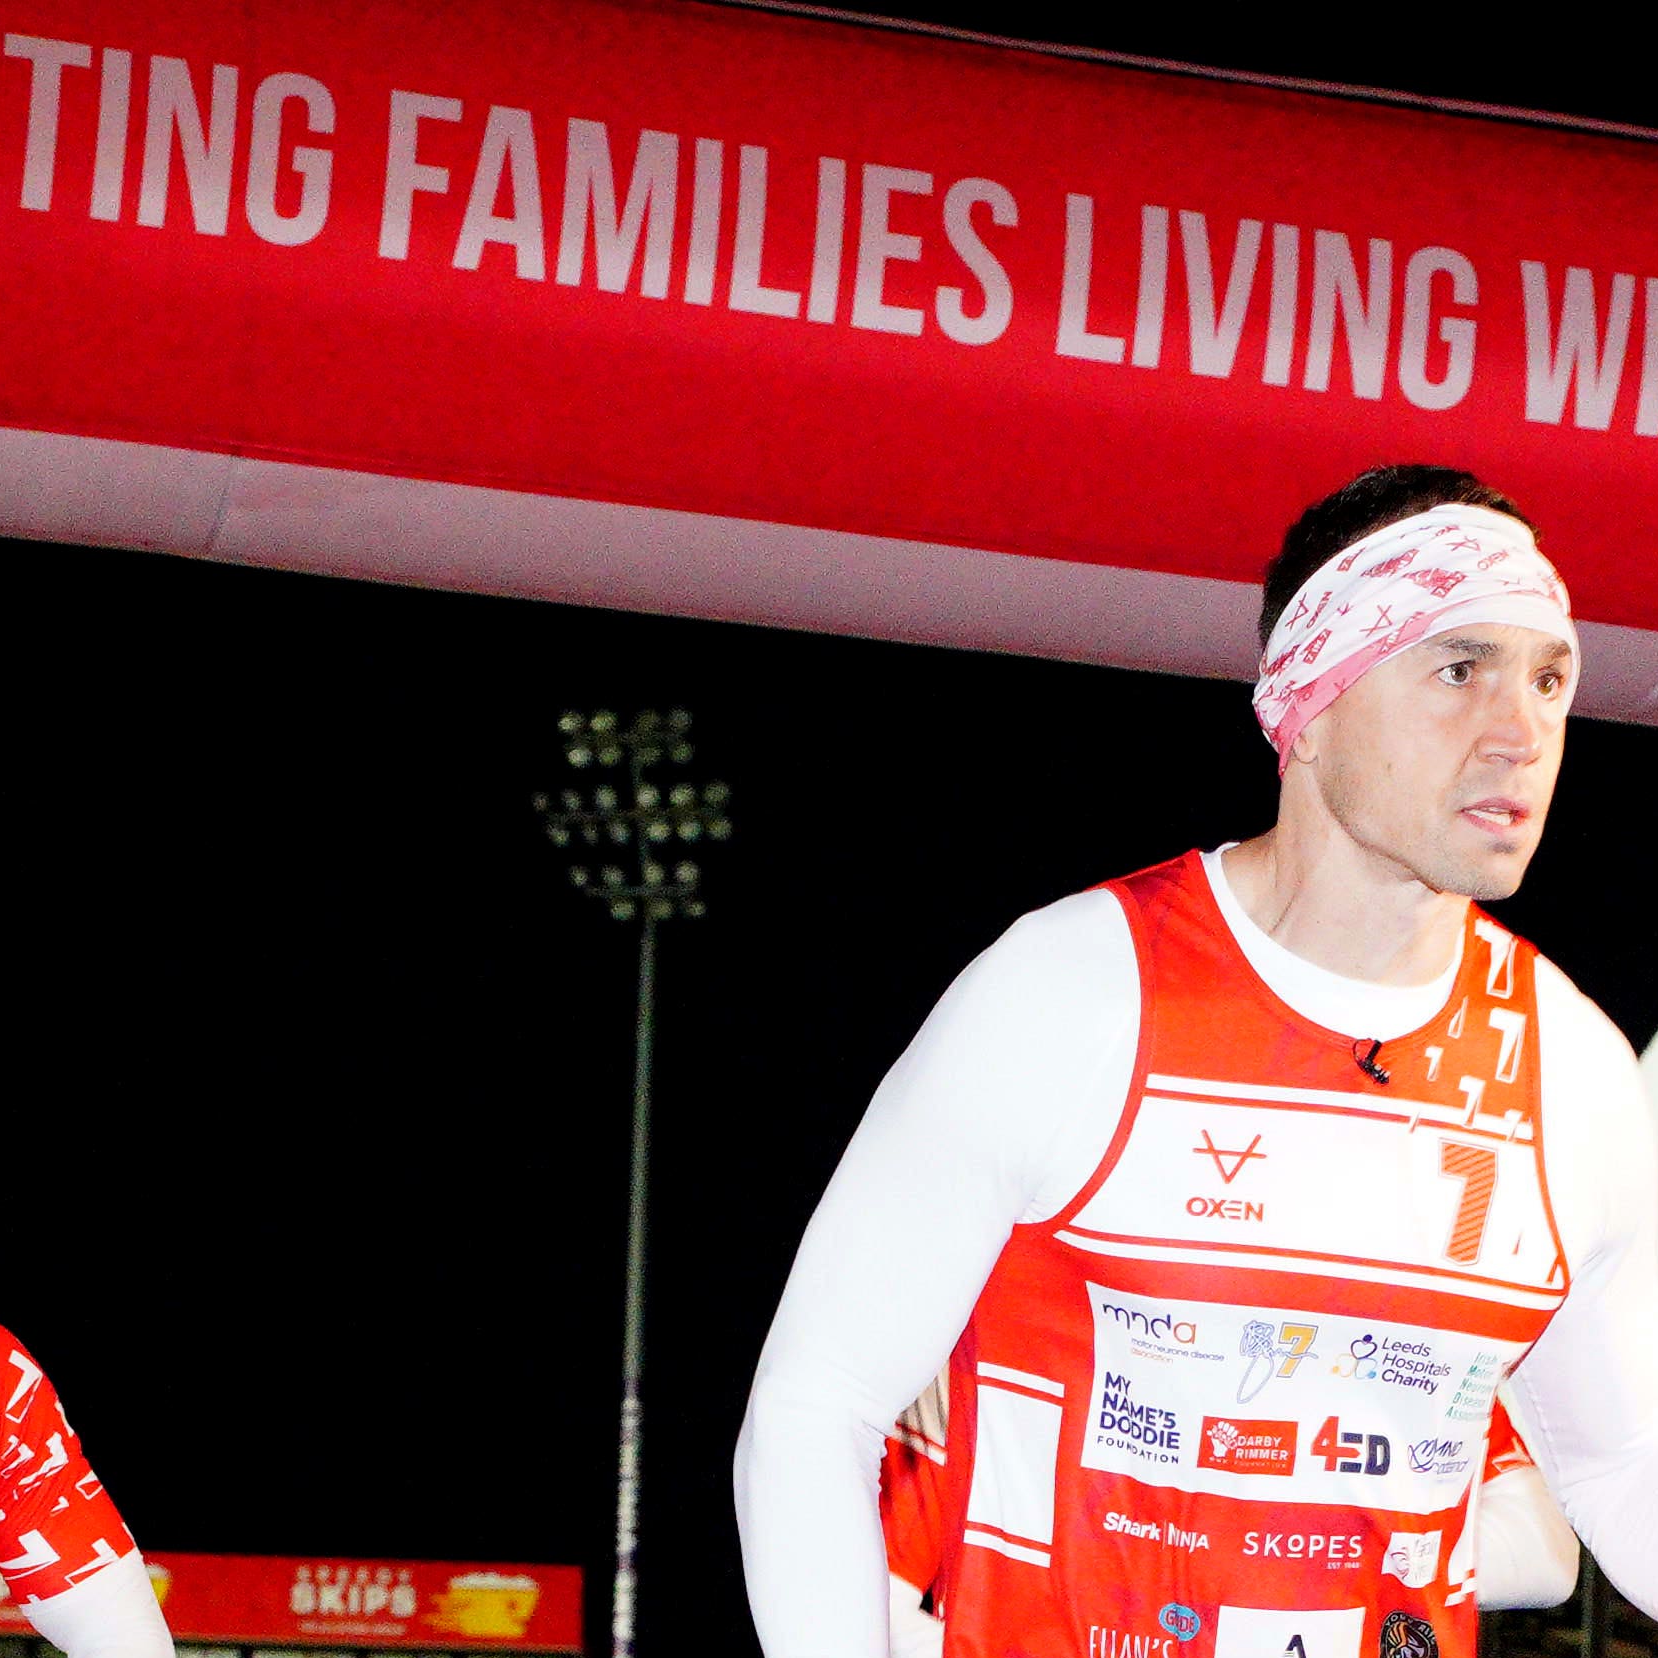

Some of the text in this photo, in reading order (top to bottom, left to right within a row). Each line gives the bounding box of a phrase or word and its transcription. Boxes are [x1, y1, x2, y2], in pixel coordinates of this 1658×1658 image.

[378, 90, 1018, 345] FAMILIES
[1056, 192, 1478, 410] LIVING
[1186, 1197, 1264, 1222] OXEN
[1439, 1138, 1497, 1265] 7
[1382, 1337, 1431, 1357] Leeds
[1382, 1353, 1452, 1376] Hospitals
[1105, 1371, 1131, 1396] MY
[1382, 1369, 1439, 1395] Charity
[1102, 1391, 1176, 1430] NAME'S
[1099, 1412, 1181, 1450] DODDIE
[1237, 1436, 1282, 1447] DARBY
[1236, 1449, 1288, 1460] RIMMER
[1103, 1511, 1161, 1541] Shark
[1243, 1531, 1363, 1560] SKOPES
